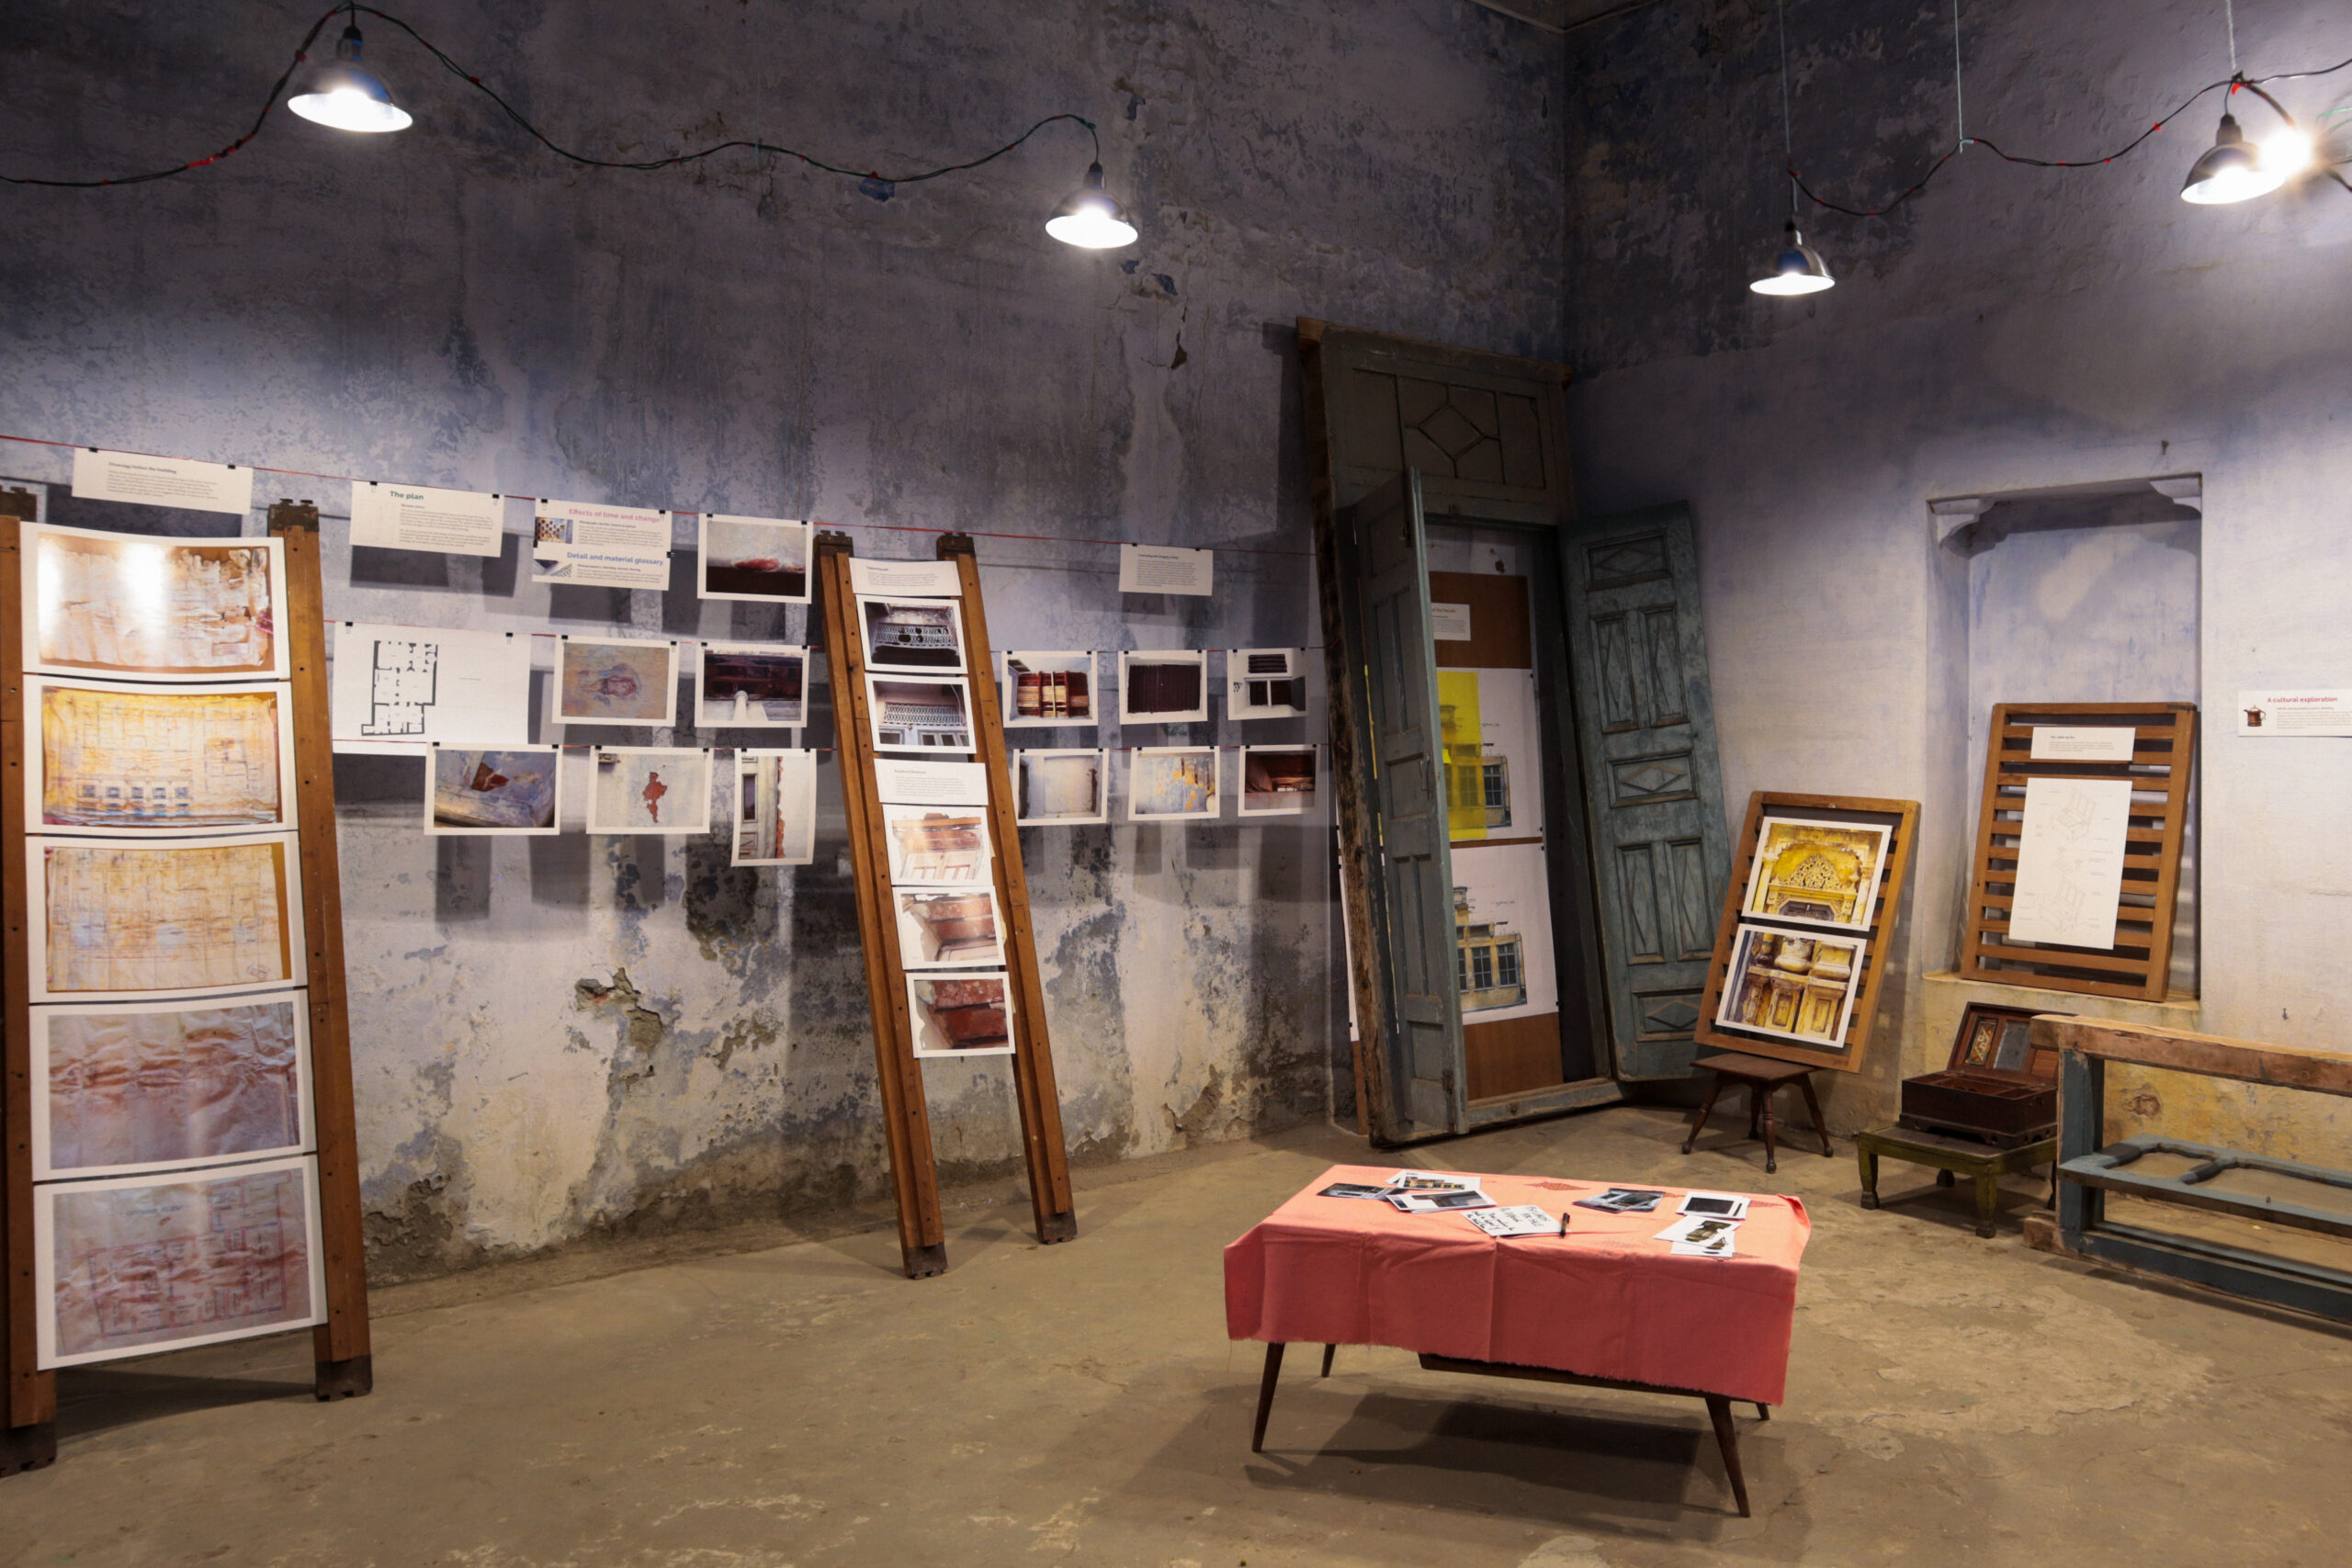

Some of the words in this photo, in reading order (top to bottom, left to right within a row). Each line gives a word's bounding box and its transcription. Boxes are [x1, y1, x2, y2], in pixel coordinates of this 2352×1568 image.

[406, 492, 424, 501] plan
[569, 508, 593, 516] Effects
[635, 514, 660, 524] change
[605, 555, 634, 563] material
[634, 558, 664, 566] glossary
